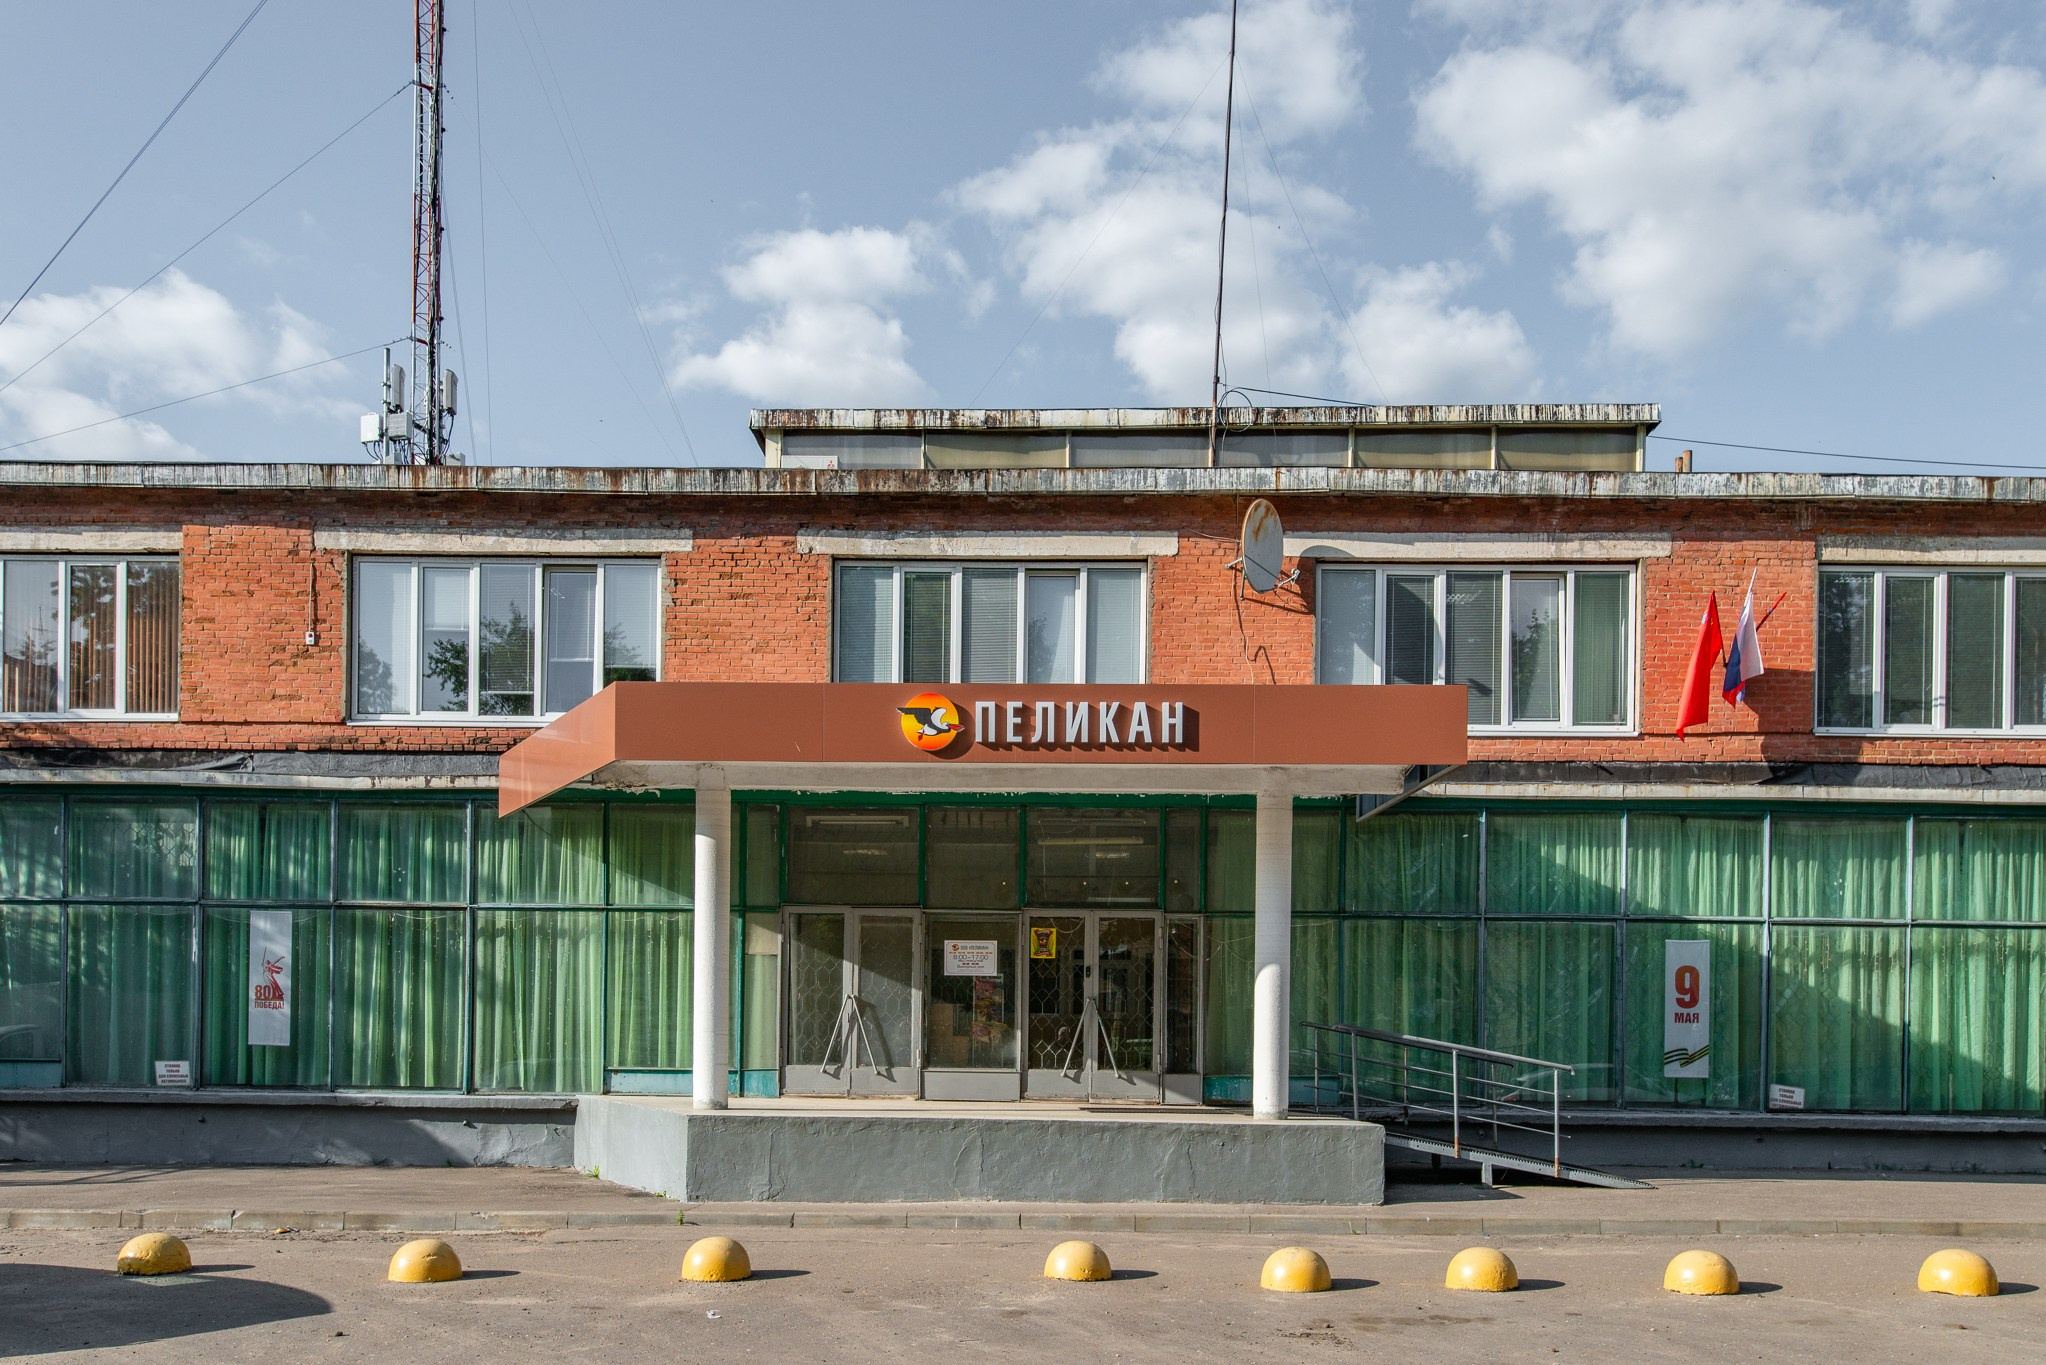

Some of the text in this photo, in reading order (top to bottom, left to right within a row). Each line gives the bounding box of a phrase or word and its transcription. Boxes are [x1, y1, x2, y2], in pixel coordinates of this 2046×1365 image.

[975, 701, 1183, 743] ПЕЛИКАН
[255, 984, 271, 999] 80
[1675, 965, 1700, 1009] 9
[254, 1001, 284, 1010] ПОБЕДА!
[1674, 1012, 1700, 1024] МАЯ
